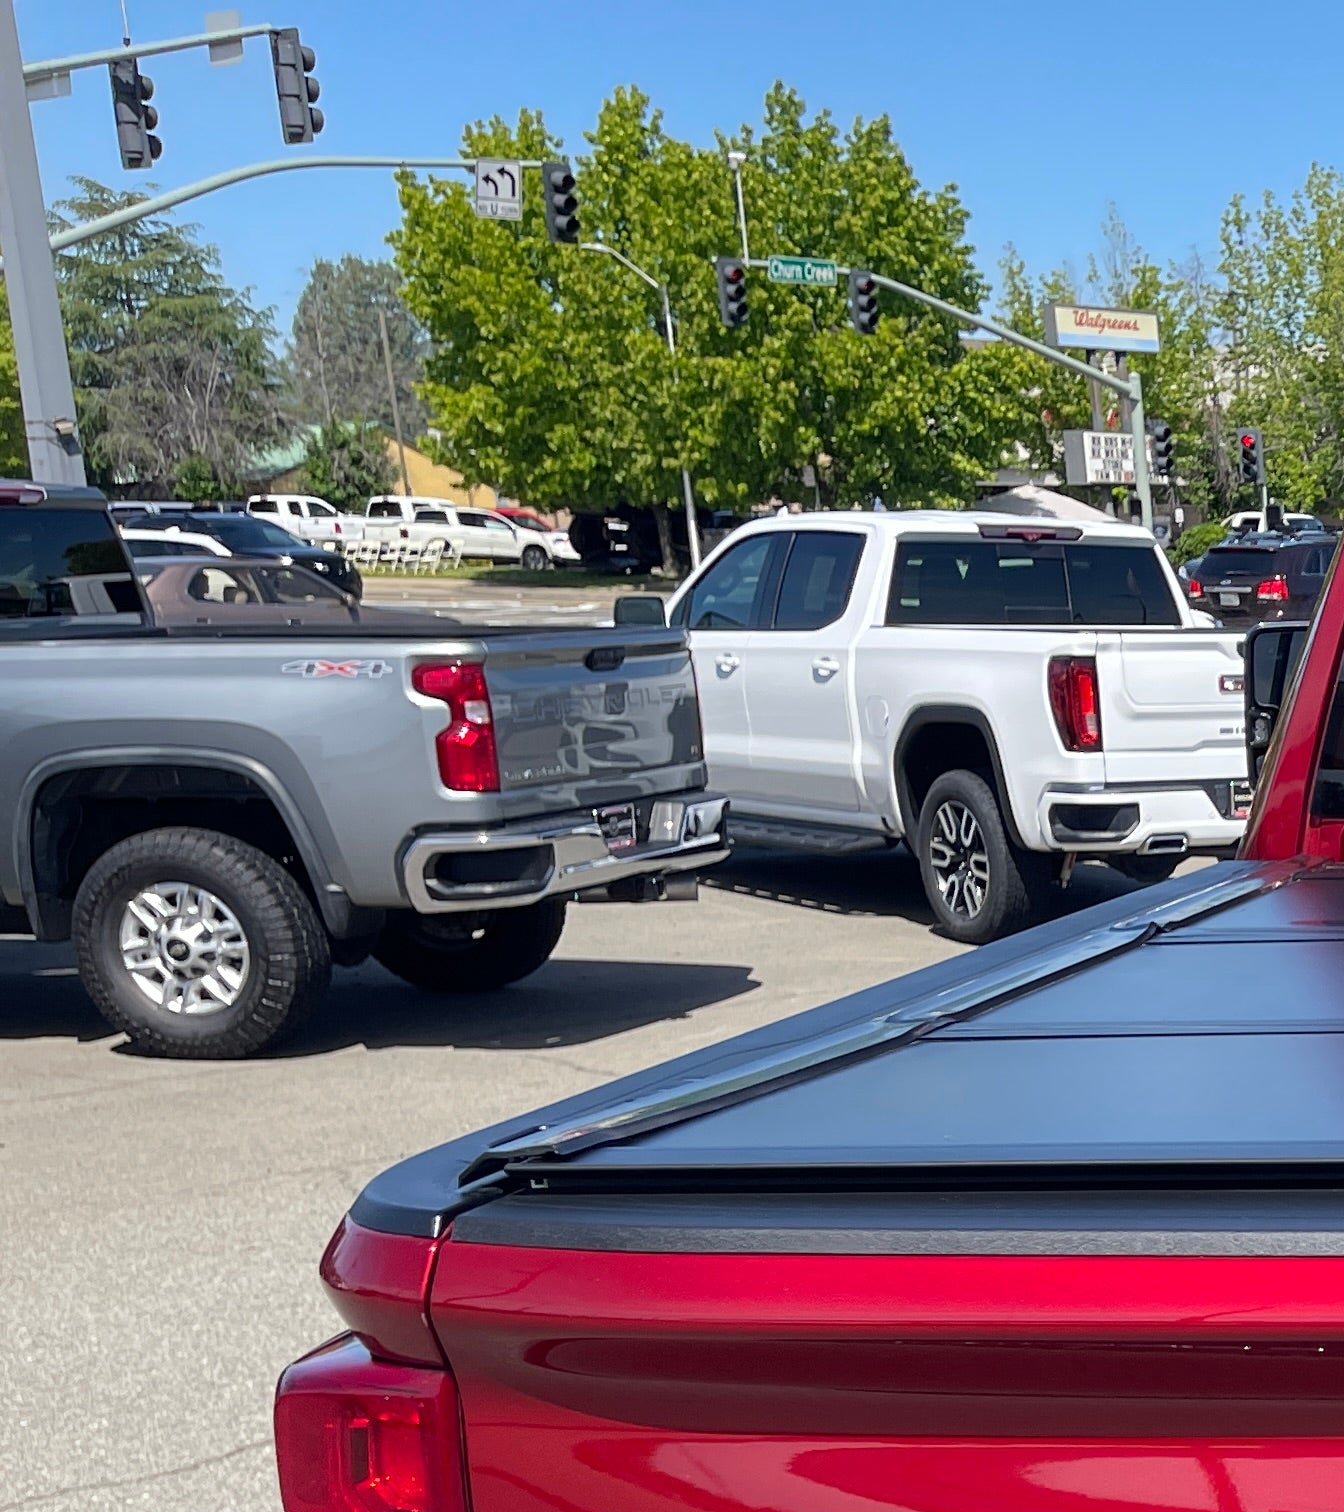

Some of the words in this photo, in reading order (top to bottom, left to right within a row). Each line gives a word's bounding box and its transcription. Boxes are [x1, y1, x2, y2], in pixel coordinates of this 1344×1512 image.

[770, 260, 803, 280] Churn
[804, 262, 835, 282] Creek
[1072, 309, 1140, 334] Walgreens
